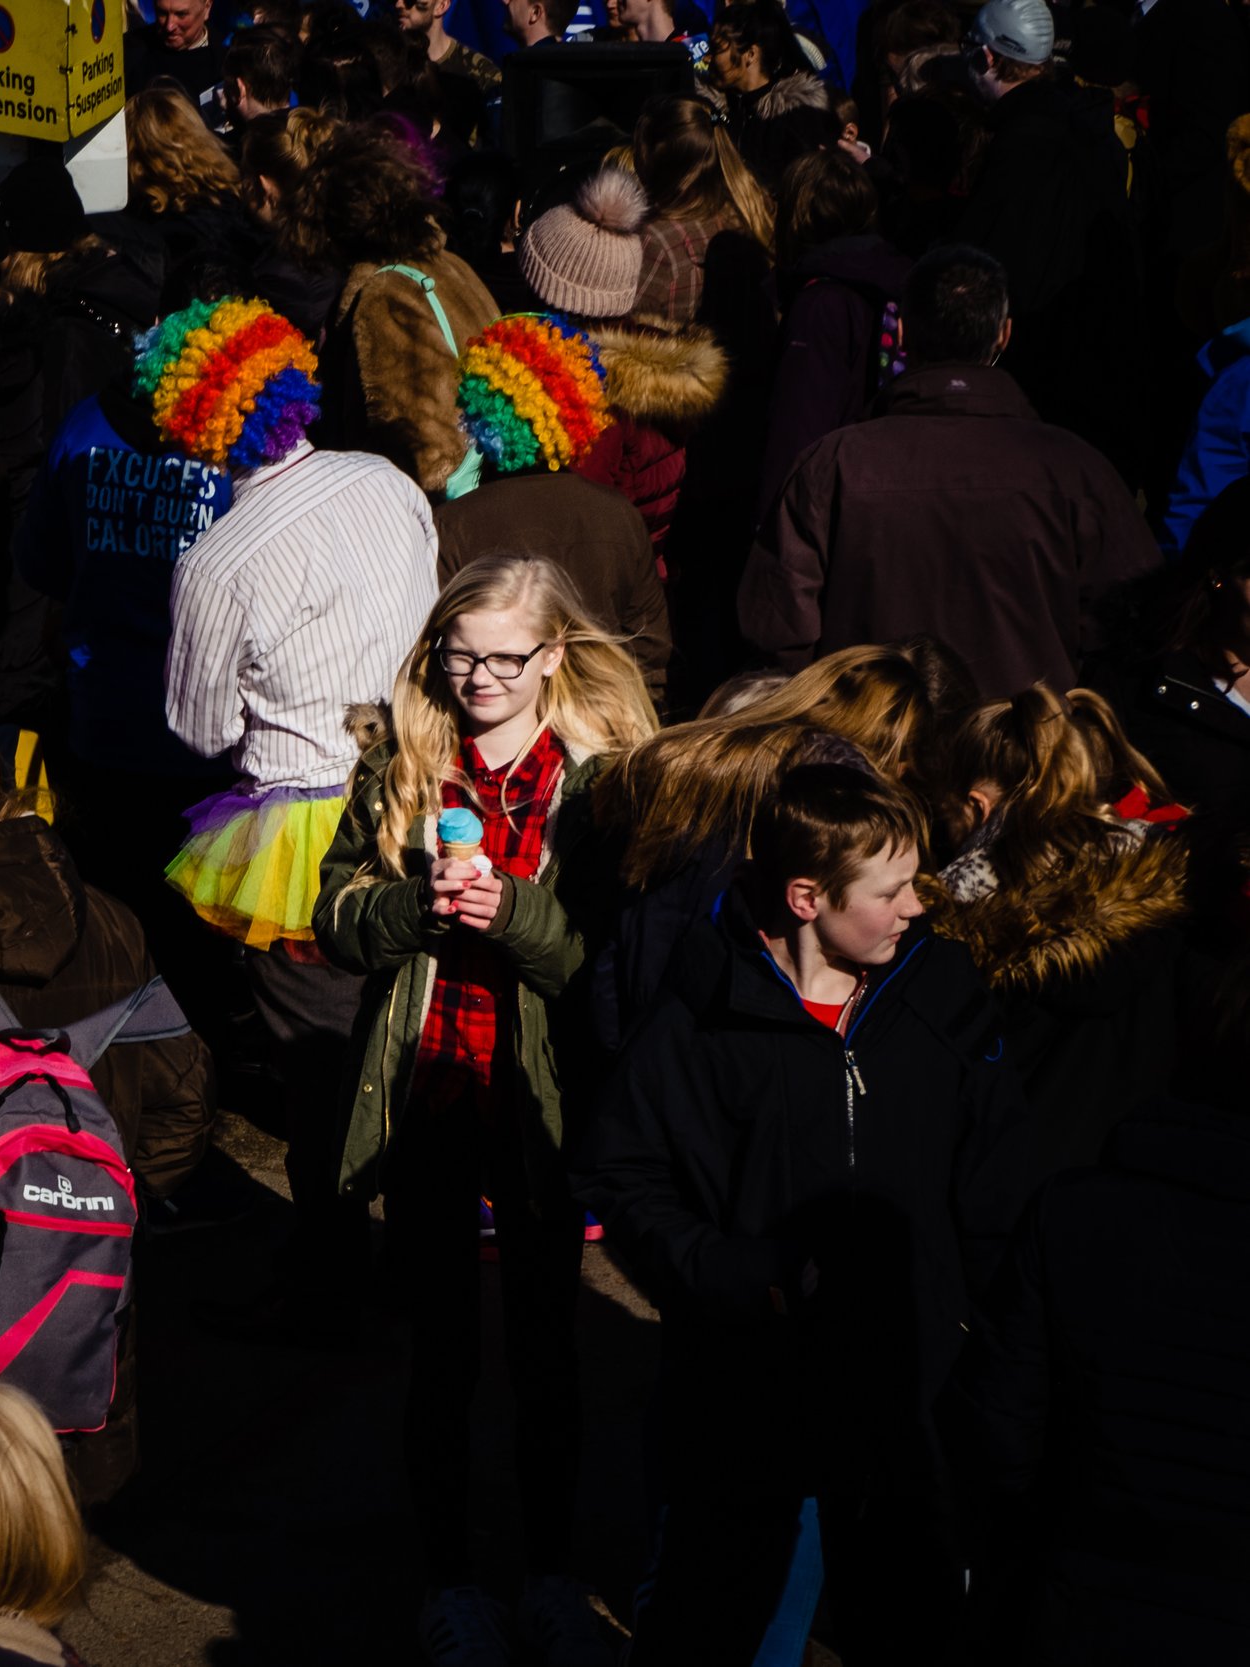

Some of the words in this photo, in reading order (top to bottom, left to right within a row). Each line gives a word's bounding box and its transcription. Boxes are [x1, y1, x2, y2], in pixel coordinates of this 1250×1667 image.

[82, 52, 114, 84] Parking
[76, 75, 122, 117] Suspension
[88, 446, 221, 500] EXCUSES
[86, 482, 148, 518] DON'T
[153, 494, 214, 530] BURN
[86, 516, 208, 561] CALORIE
[23, 1184, 114, 1210] carbrini
